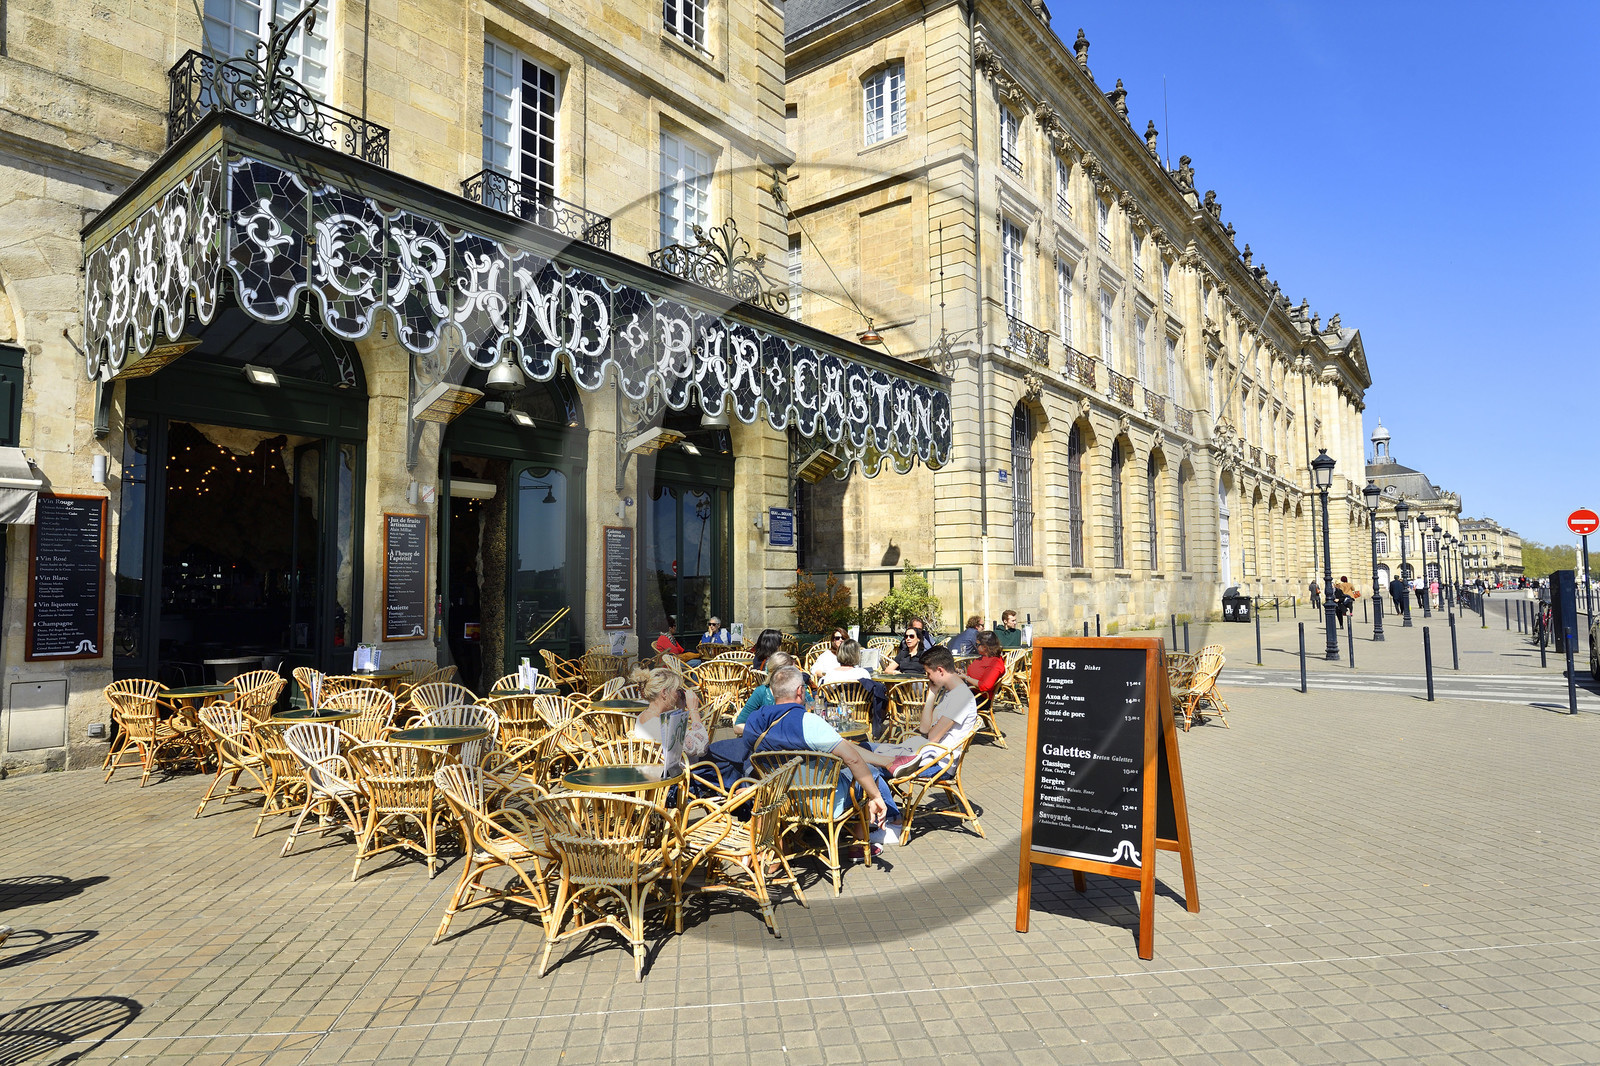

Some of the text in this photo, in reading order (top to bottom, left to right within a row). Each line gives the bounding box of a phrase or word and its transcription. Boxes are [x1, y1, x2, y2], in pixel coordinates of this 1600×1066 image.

[107, 205, 189, 332] BAR
[315, 213, 932, 439] GRAND BAR CASTAN
[1048, 659, 1076, 670] Plats
[1043, 744, 1091, 759] Galettes
[1042, 759, 1070, 769] Classique
[1041, 776, 1065, 785] Bergère
[1040, 793, 1071, 803] Forestière
[1039, 811, 1072, 822] Savoyarde
